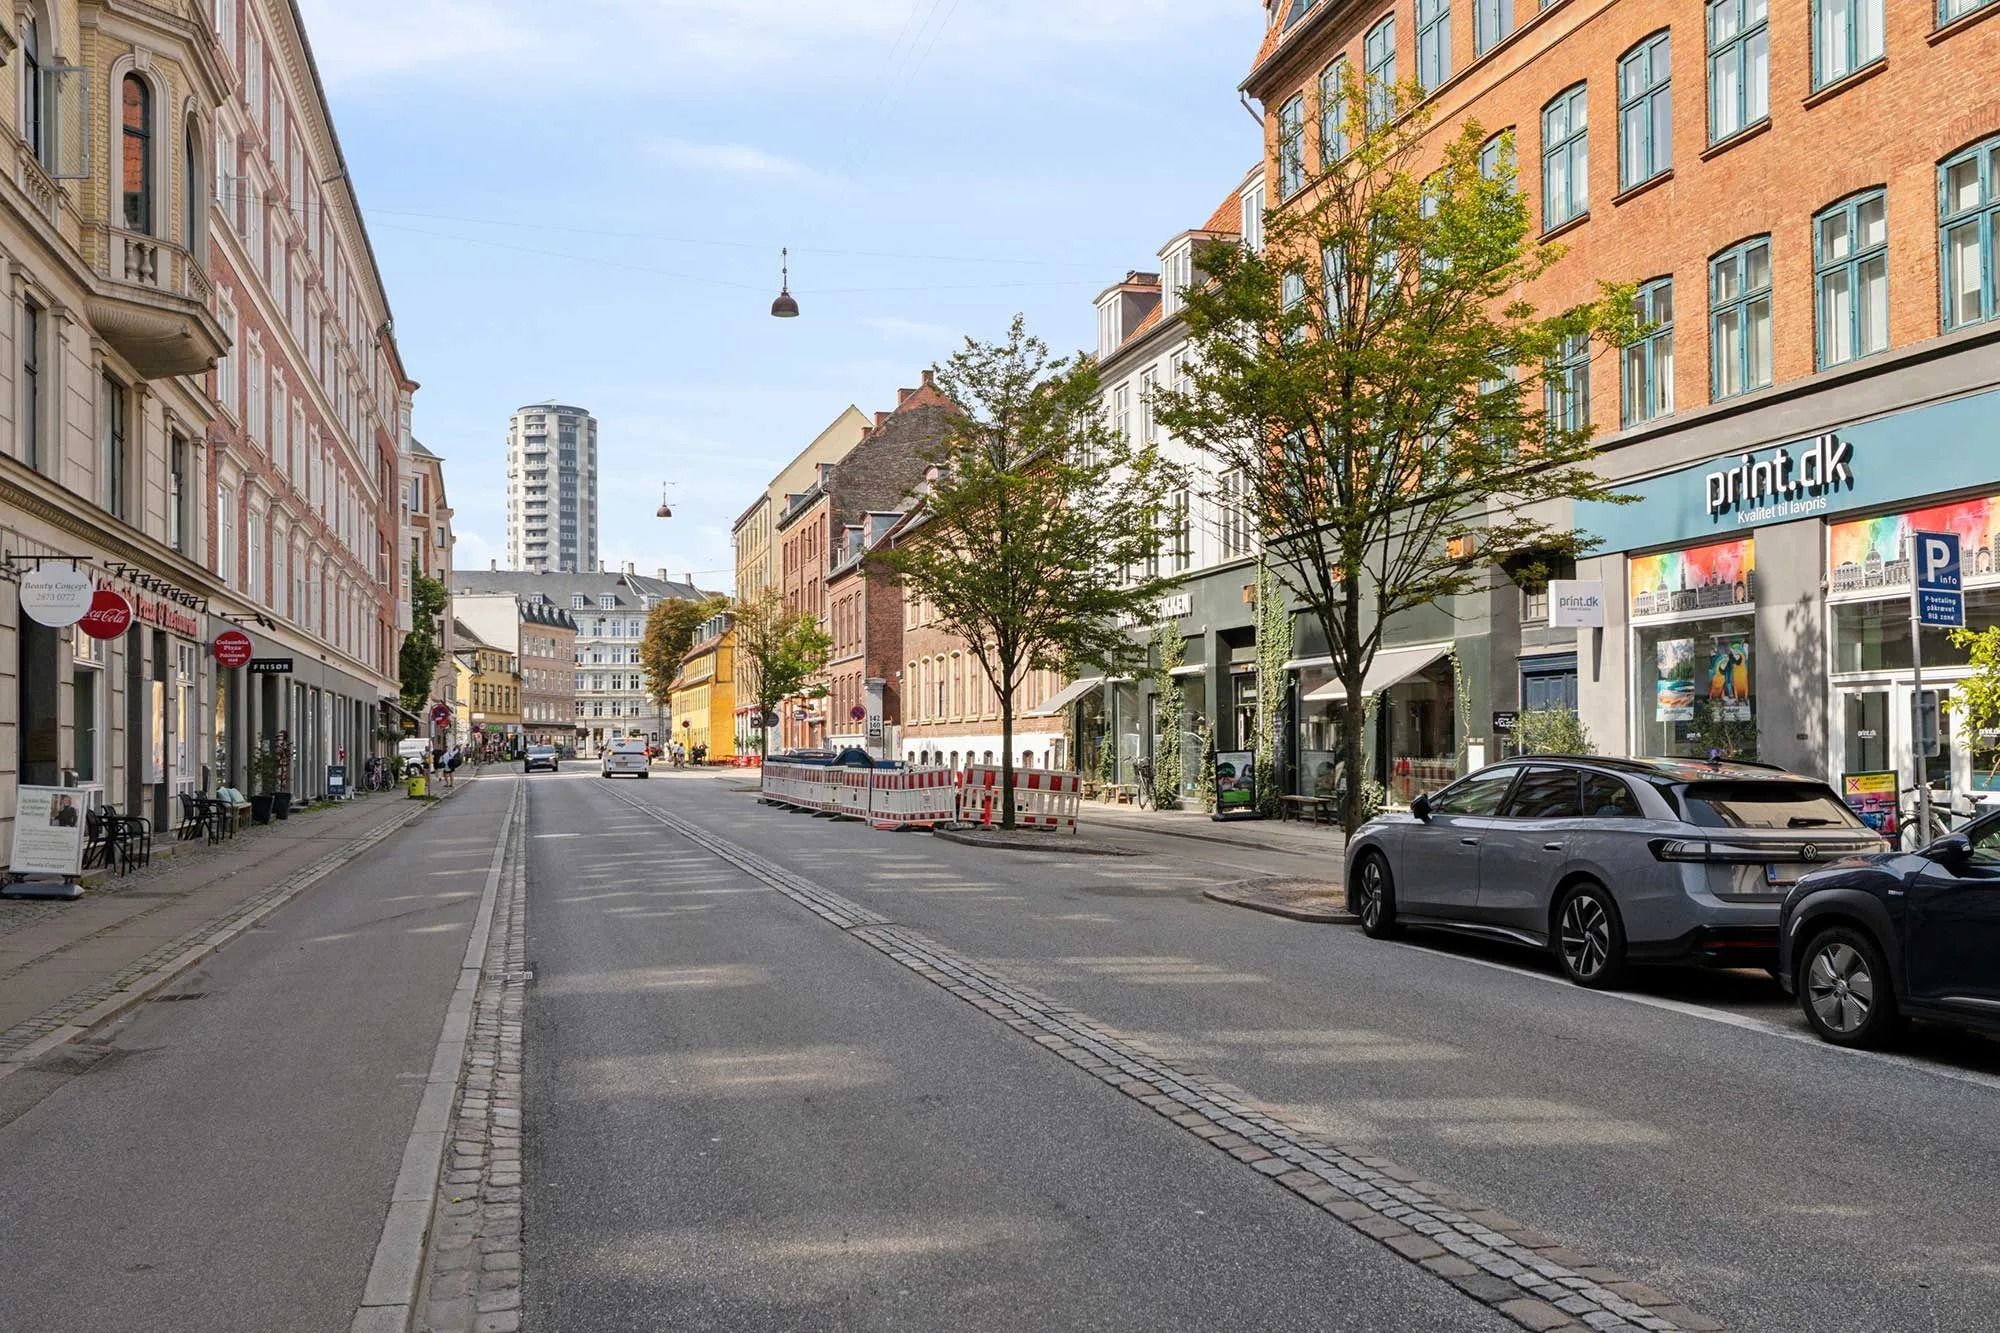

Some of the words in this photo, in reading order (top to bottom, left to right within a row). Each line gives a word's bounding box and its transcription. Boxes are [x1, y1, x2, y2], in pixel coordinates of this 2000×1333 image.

[1706, 434, 1847, 515] print.dk
[1737, 506, 1776, 524] Kvalitet
[1778, 503, 1788, 516] til
[1790, 496, 1827, 515] lavpris
[1926, 539, 1950, 583] P
[1940, 575, 1958, 585] info
[24, 582, 53, 591] Beauty
[55, 582, 87, 592] Concept
[1559, 595, 1599, 608] print.dk
[253, 663, 289, 671] FRISØR
